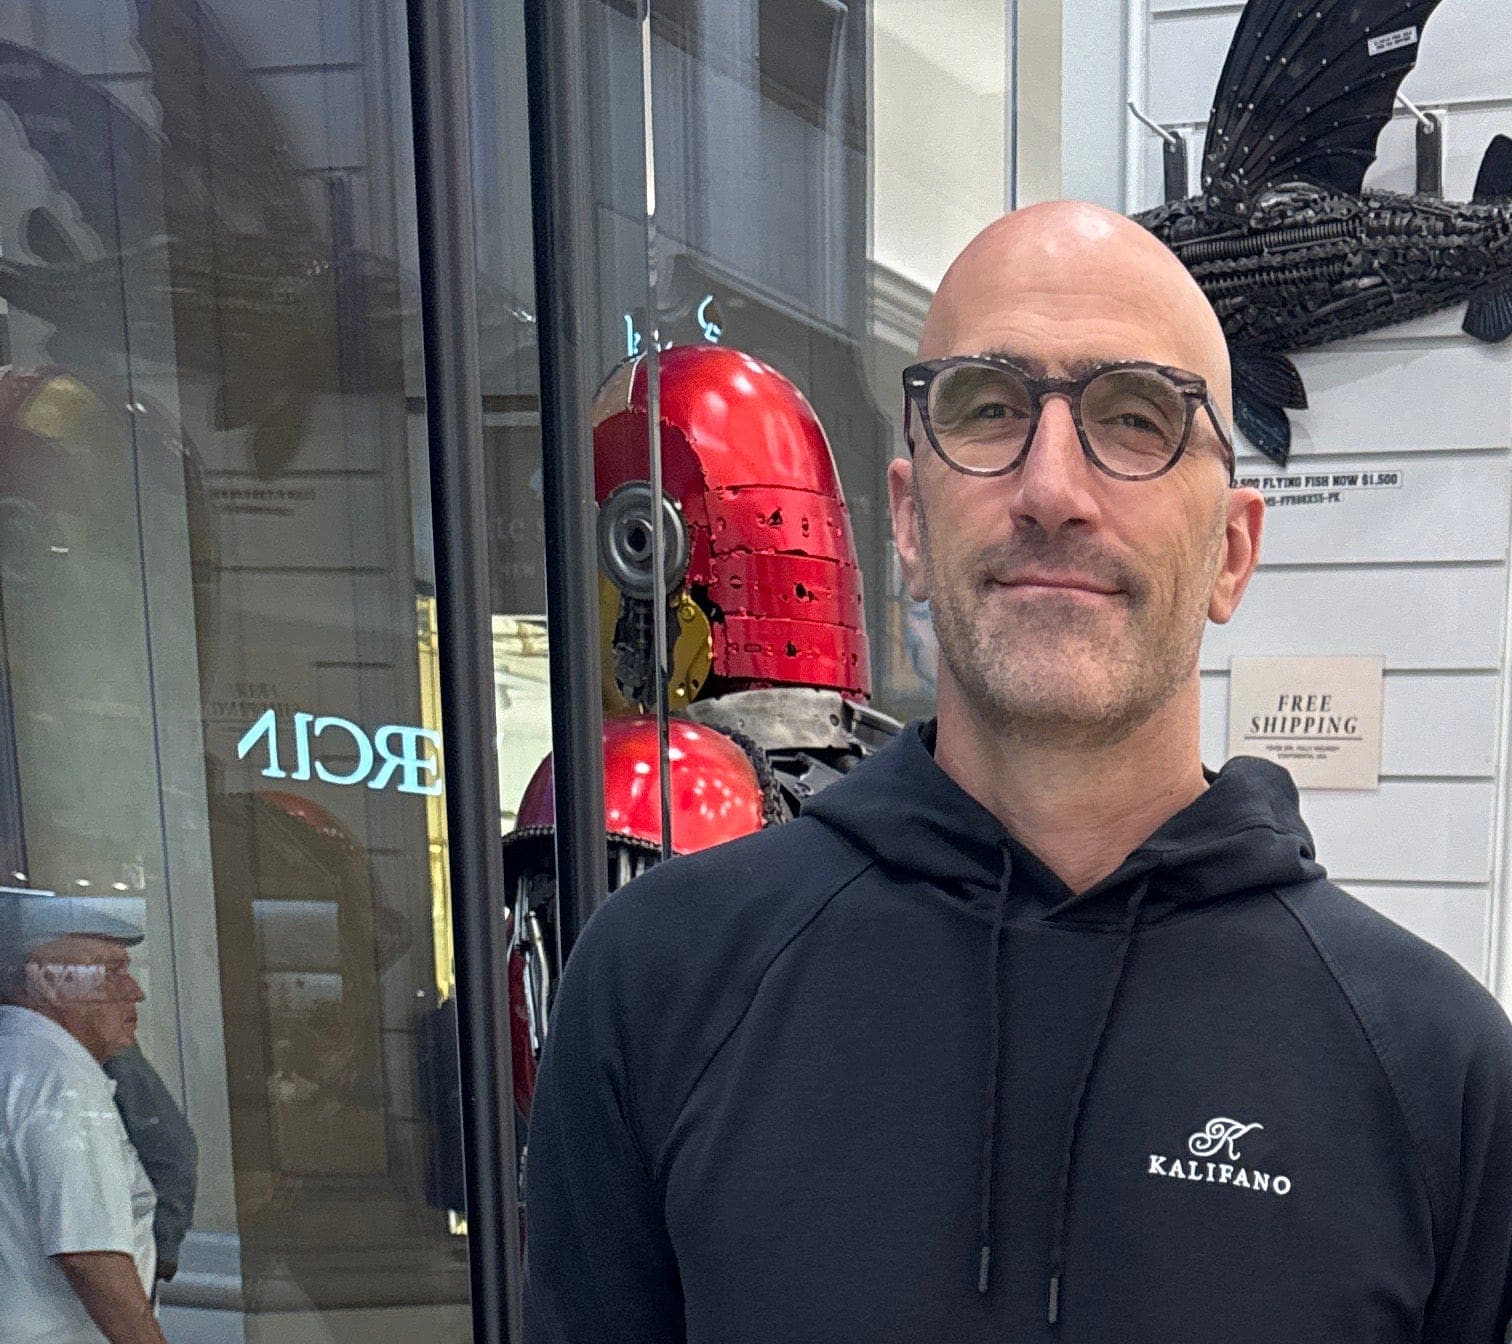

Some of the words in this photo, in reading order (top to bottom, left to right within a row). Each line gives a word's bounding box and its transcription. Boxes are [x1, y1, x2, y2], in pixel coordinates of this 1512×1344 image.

[1262, 475, 1302, 490] FLYING
[1304, 475, 1329, 489] FISH
[1332, 473, 1359, 487] NOW
[1277, 693, 1333, 713] FREE
[1250, 715, 1359, 735] SHIPPING
[1148, 1154, 1292, 1195] KALIFANO
